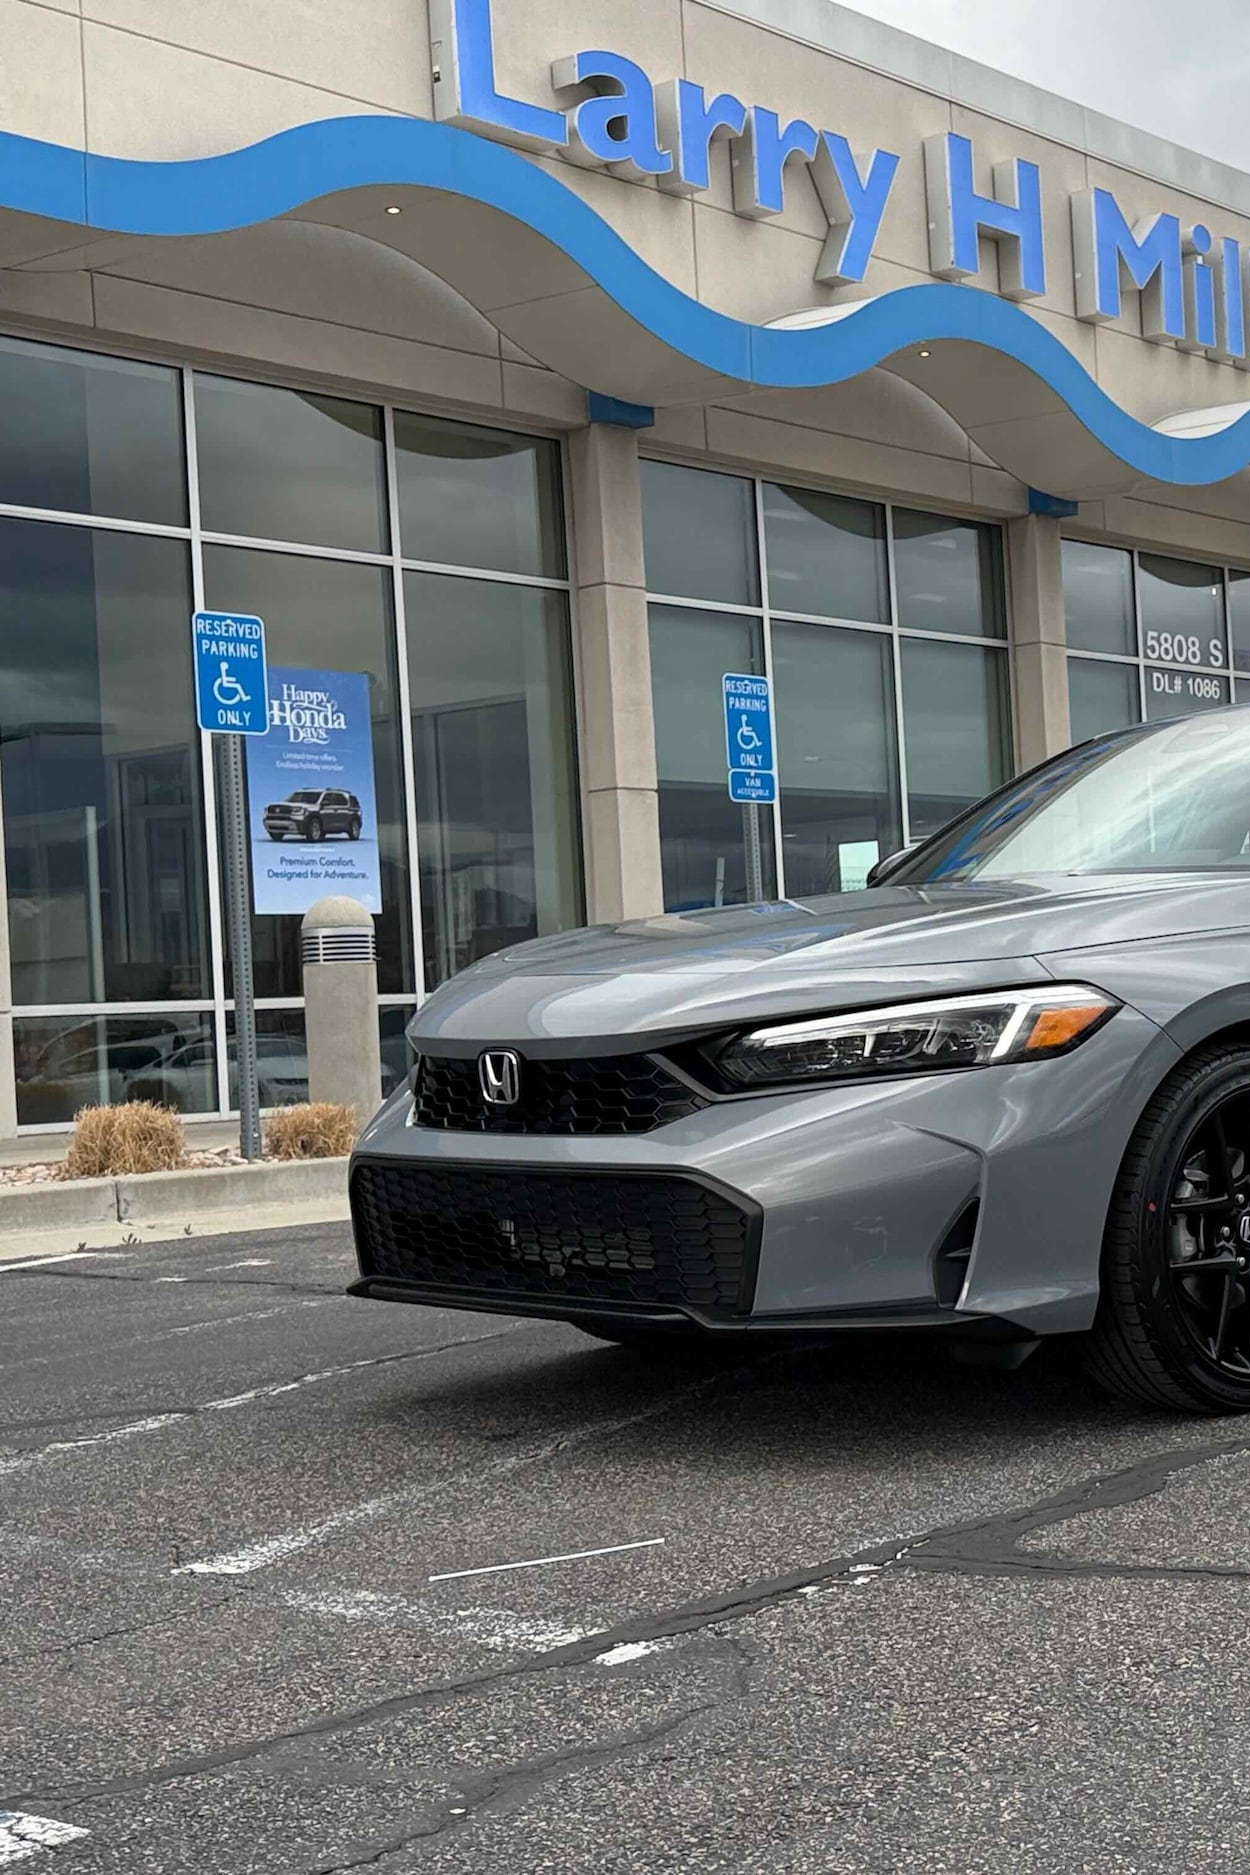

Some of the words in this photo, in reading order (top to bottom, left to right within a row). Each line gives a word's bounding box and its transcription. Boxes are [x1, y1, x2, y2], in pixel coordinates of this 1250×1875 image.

[450, 0, 901, 284] Larry
[946, 131, 1046, 297] H
[196, 618, 261, 640] RESERVED
[201, 639, 259, 659] PARKING
[1146, 630, 1201, 664] 5808
[1209, 638, 1224, 667] S
[725, 680, 768, 696] RESERVED
[1152, 672, 1182, 694] DL#
[1187, 677, 1221, 699] 1086
[282, 683, 335, 711] Happy
[728, 697, 767, 712] PARKING
[217, 708, 252, 726] ONLY
[269, 699, 347, 729] Honda
[740, 753, 763, 766] ONLY
[744, 777, 762, 787] VAN
[279, 856, 318, 866] Premium
[266, 868, 308, 880] Designed
[310, 870, 322, 879] for
[323, 870, 370, 880] Adventure.
